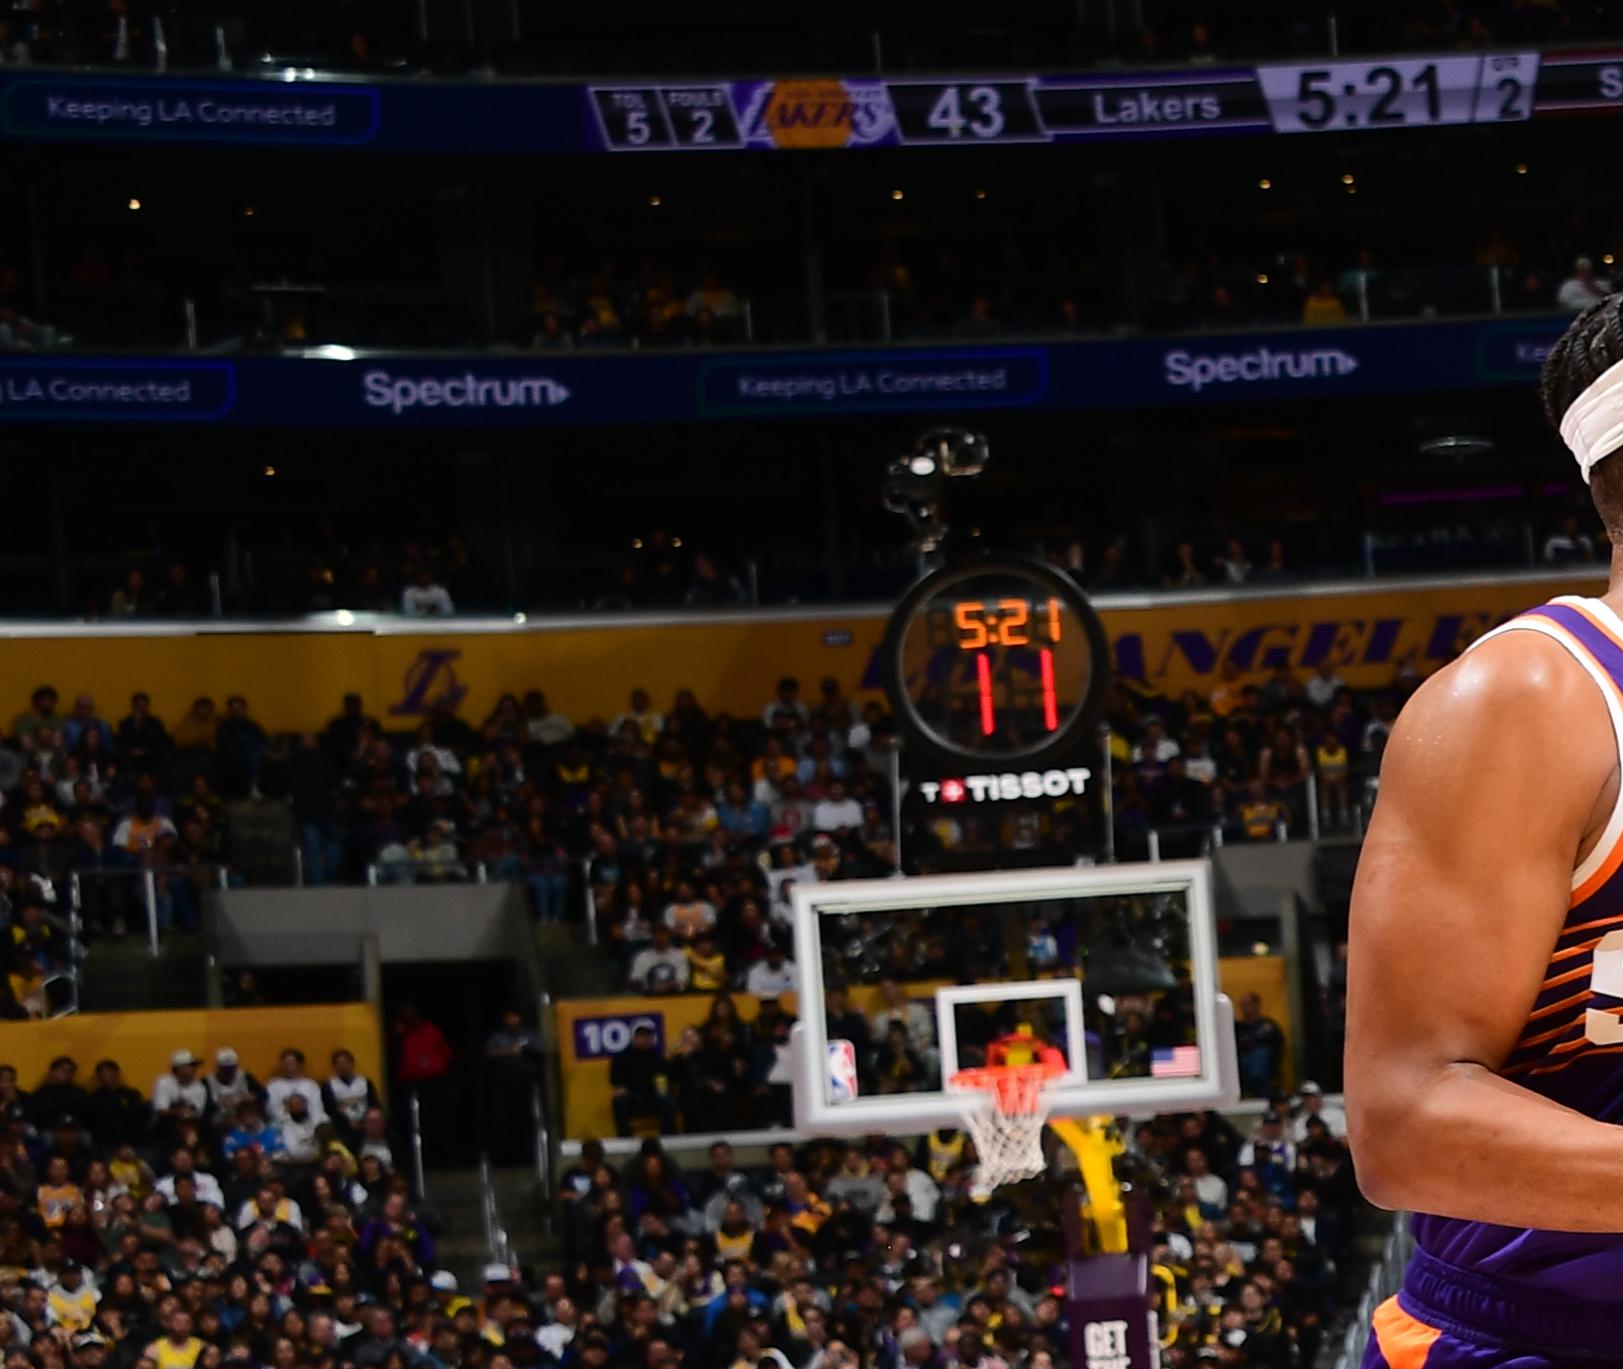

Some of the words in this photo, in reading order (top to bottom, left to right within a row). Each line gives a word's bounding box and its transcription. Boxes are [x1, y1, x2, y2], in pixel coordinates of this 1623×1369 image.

[47, 95, 152, 127] Keeping
[157, 99, 194, 123] LA
[199, 100, 337, 127] Connected
[928, 86, 1004, 138] 43
[1094, 90, 1222, 124] Lakers
[1299, 64, 1441, 128] 5:21
[1496, 78, 1521, 120] 2
[625, 110, 651, 145] 5
[691, 110, 716, 144] 2
[738, 374, 837, 400] Keeping
[838, 371, 873, 395] LA
[878, 366, 1007, 395] Connected
[1163, 347, 1357, 392] Spectrum
[6, 378, 43, 401] LA
[48, 377, 191, 402] Connected
[362, 371, 566, 415] Spectrum
[953, 597, 1062, 650] 5:21
[1108, 612, 1498, 688] ANGELE
[976, 647, 1060, 737] 11
[964, 766, 1092, 803] TISSOT
[1084, 1320, 1129, 1357] GET
